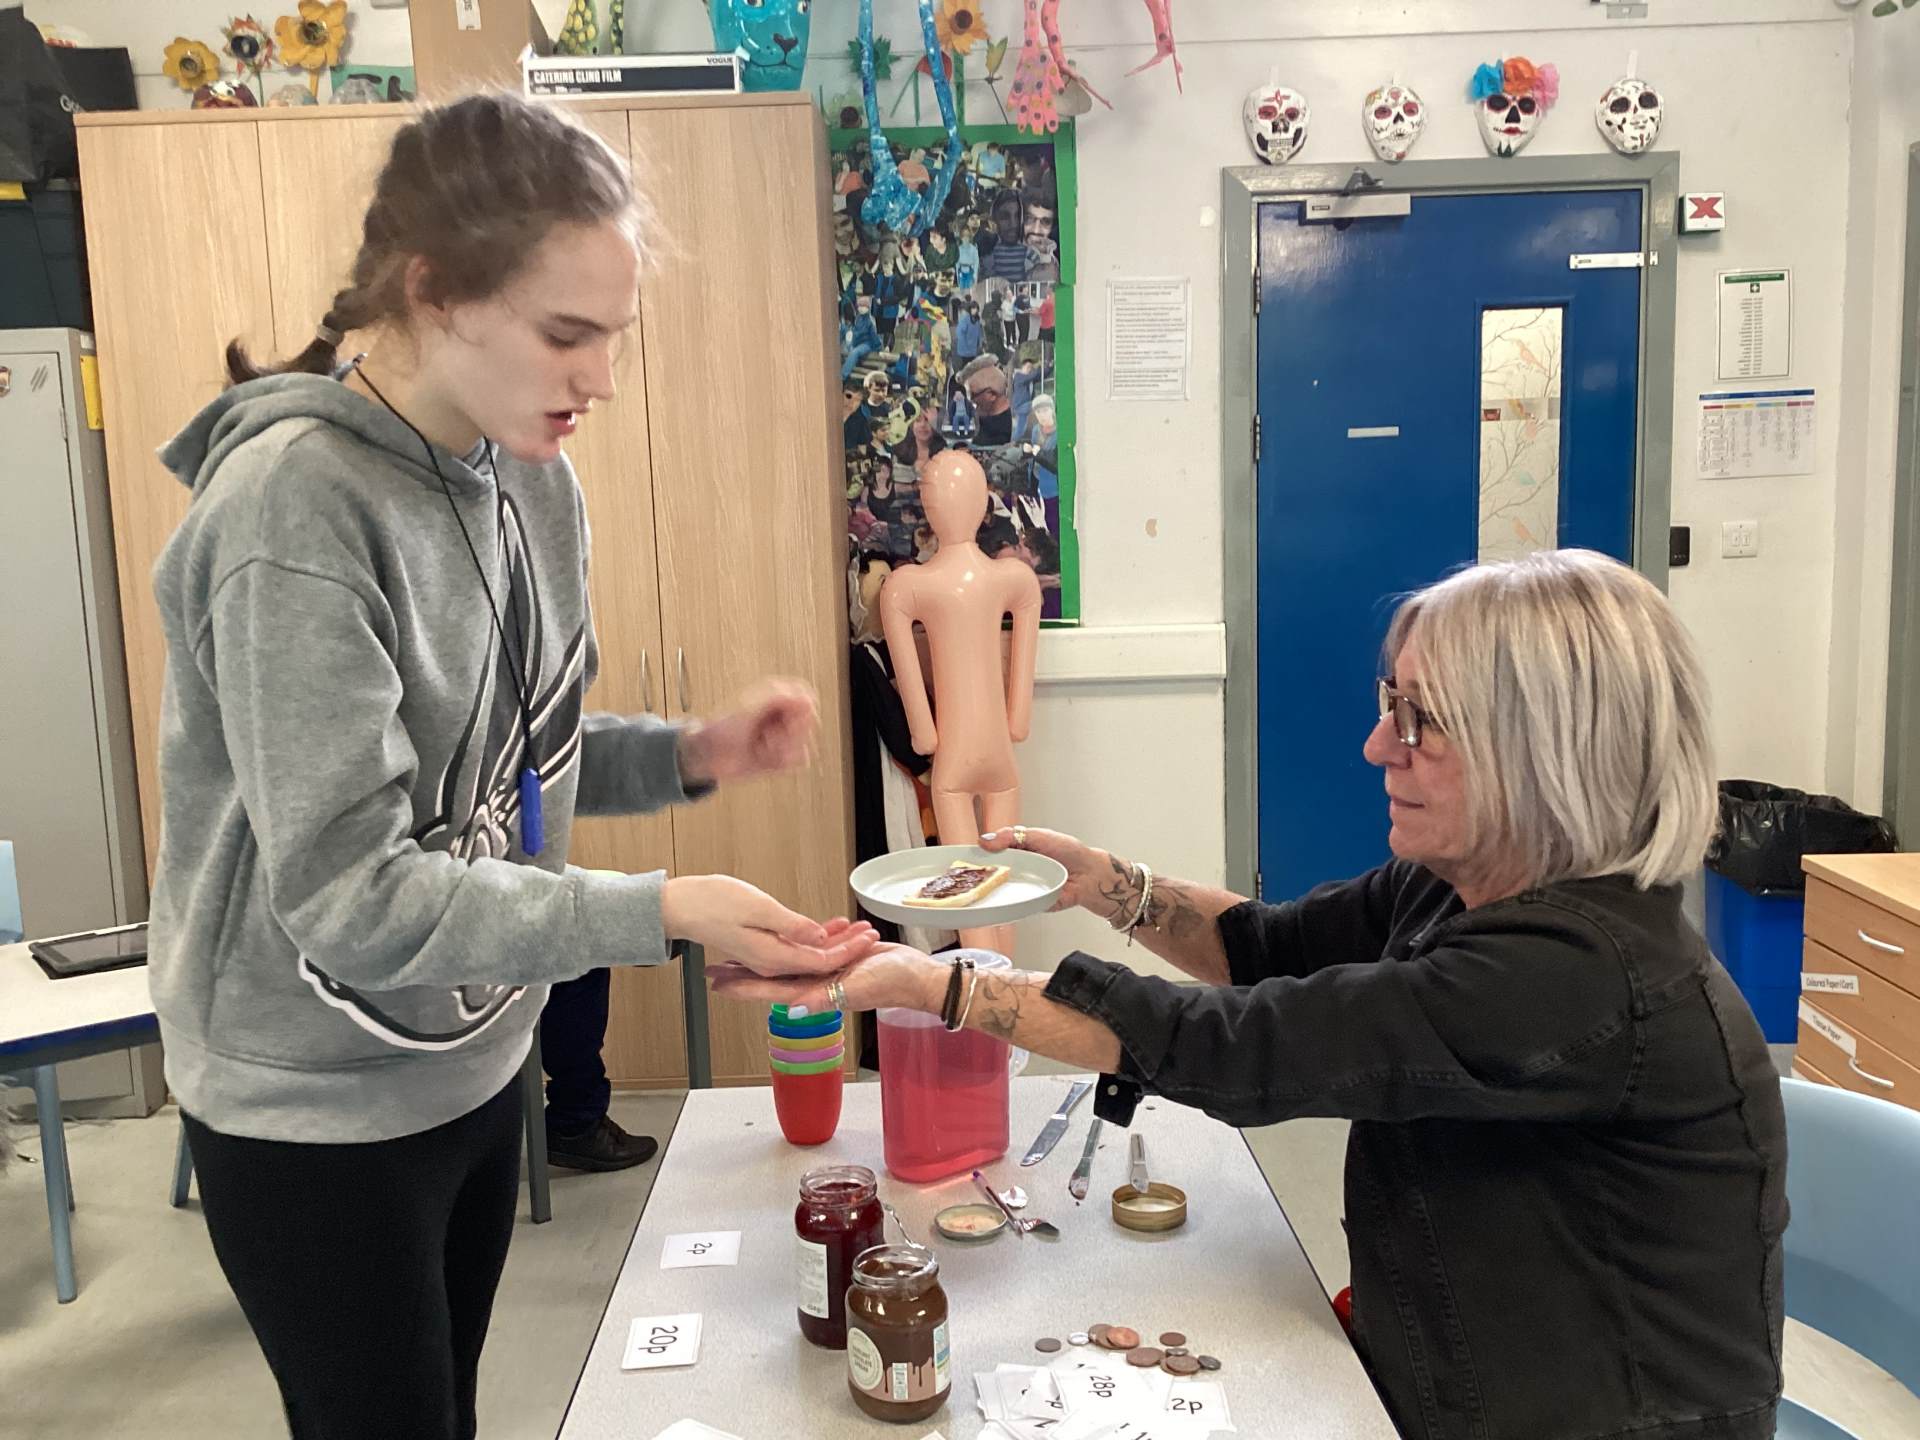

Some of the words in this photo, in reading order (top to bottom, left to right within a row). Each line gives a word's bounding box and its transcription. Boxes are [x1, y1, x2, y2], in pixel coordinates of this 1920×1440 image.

[534, 70, 575, 84] CATERING
[576, 69, 600, 83] CLING
[601, 69, 622, 82] FILM
[1812, 1014, 1827, 1031] Tissue
[1827, 1026, 1841, 1041] Paper
[686, 1242, 713, 1255] 2p
[638, 1325, 679, 1354] 20p
[1088, 1375, 1116, 1398] 28p
[1171, 1397, 1203, 1415] 2p
